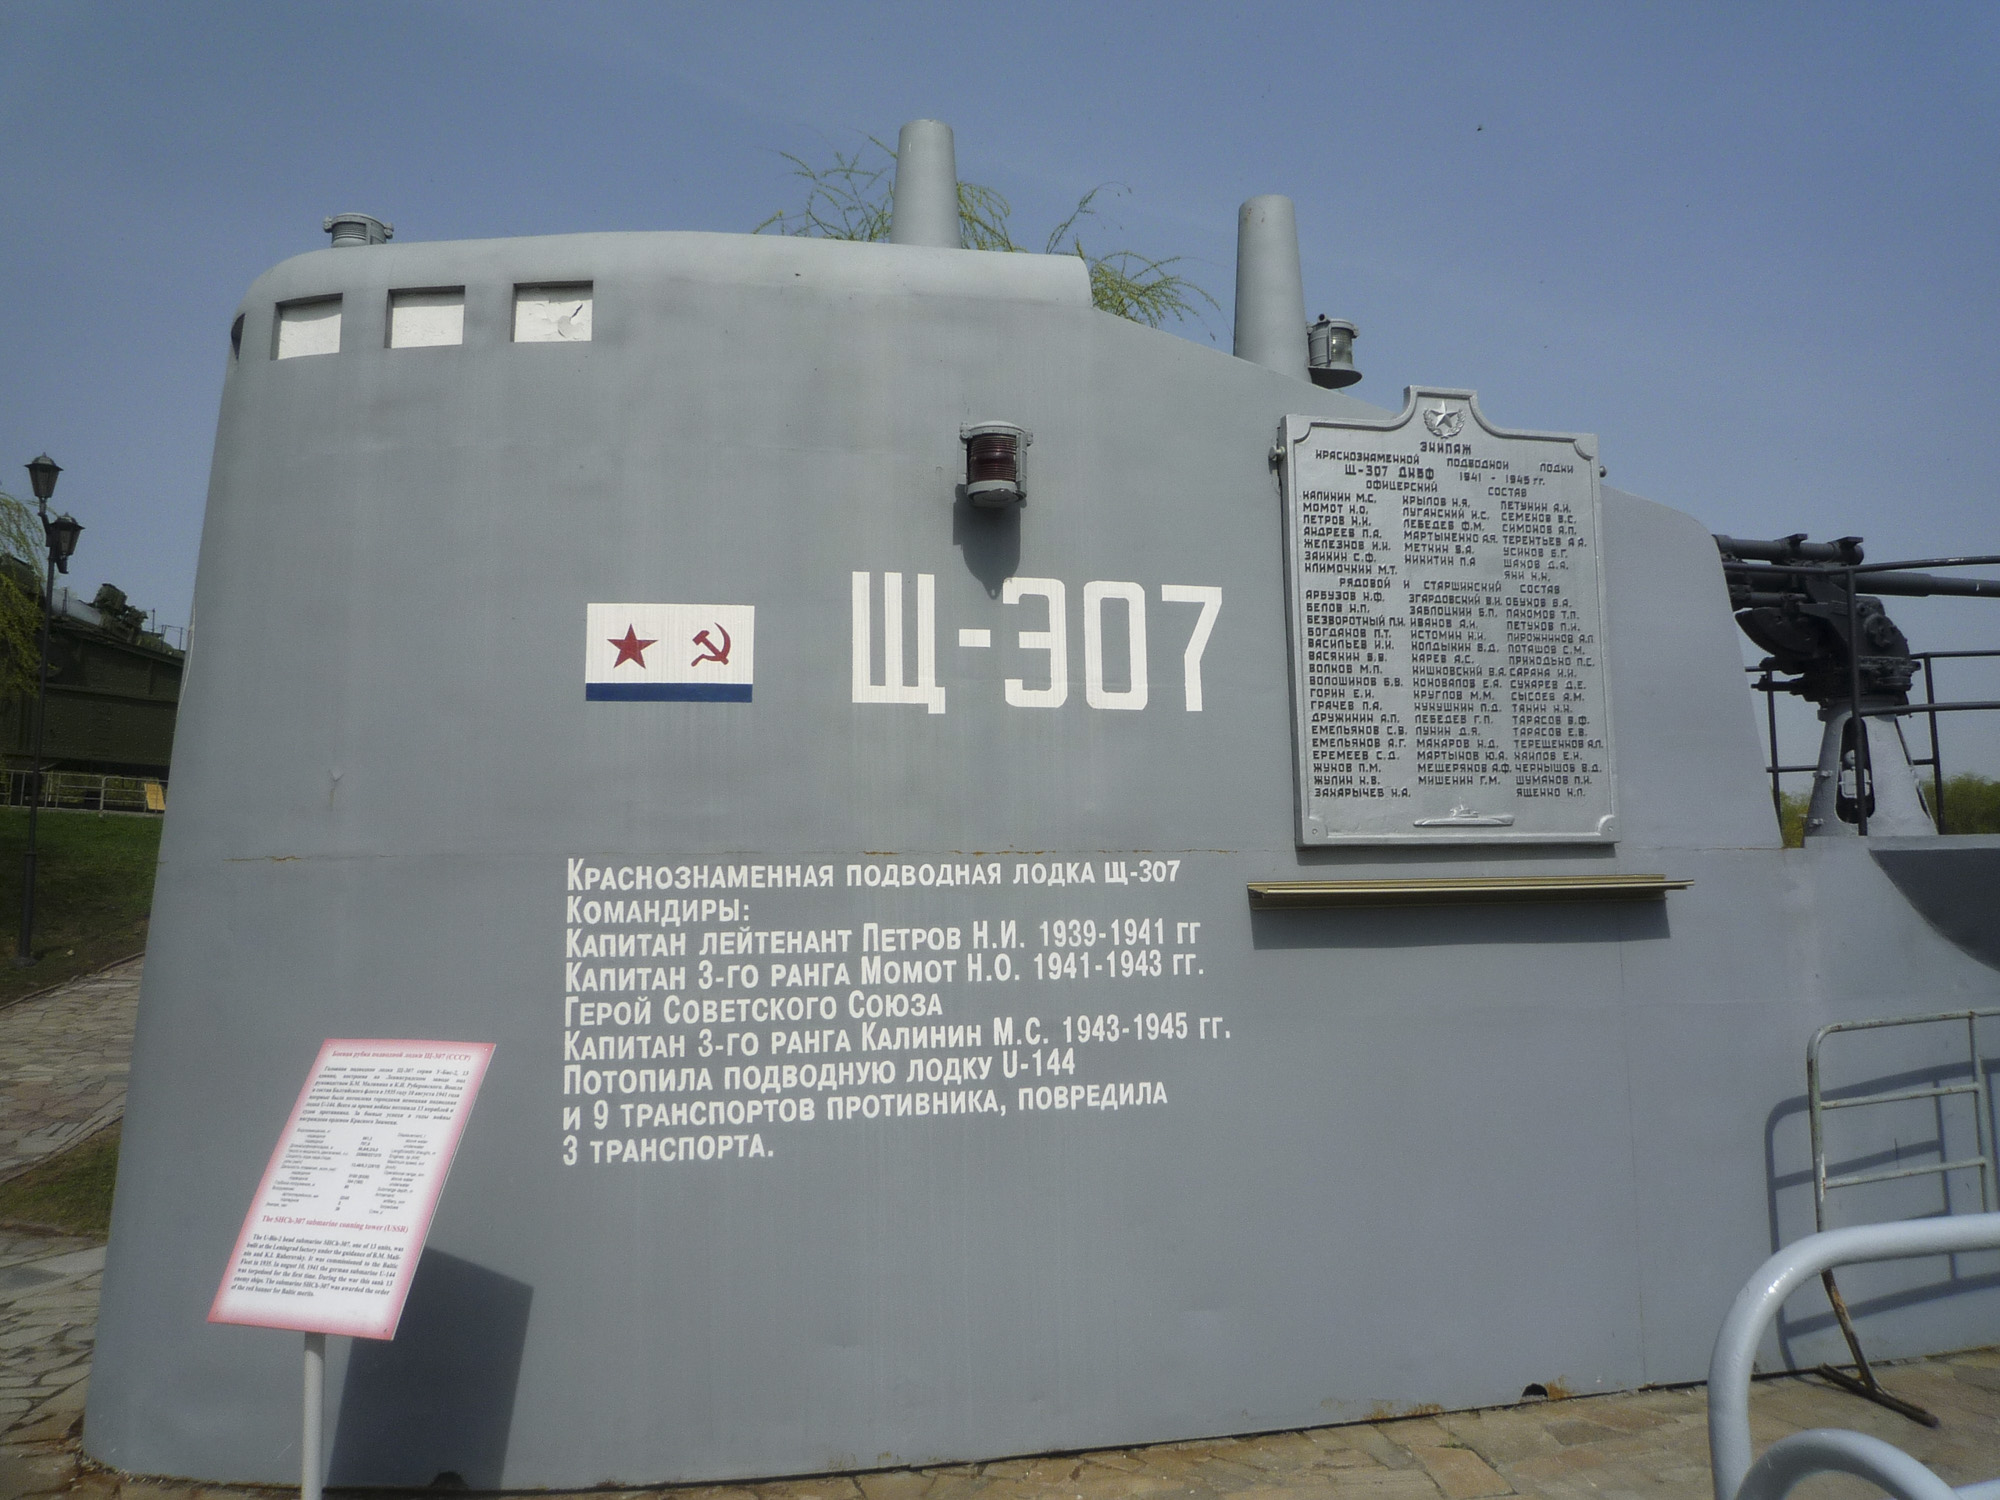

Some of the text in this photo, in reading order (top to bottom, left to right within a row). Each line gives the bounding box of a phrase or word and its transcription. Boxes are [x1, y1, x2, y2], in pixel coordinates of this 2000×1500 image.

[1419, 441, 1471, 455] ЭКИПАЖ
[1315, 449, 1419, 465] КРАСНОЗНАМЕННОЙ
[1539, 462, 1574, 474] ЛОДКИ
[1398, 466, 1434, 480] ДКБФ
[1459, 471, 1481, 482] 1941
[1505, 474, 1530, 485] 1945
[1365, 479, 1527, 497] ОФИЦЕРСКИЙ СОСТАВ
[1302, 490, 1351, 502] КАЛИНИН
[1402, 495, 1446, 506] КРЫЛОВ
[1302, 502, 1343, 513] МОМОТ
[1402, 507, 1464, 519] ЛУГАНСКИЙ
[1303, 514, 1344, 525] ПЕТРОВ
[1501, 511, 1551, 523] СЕМЕНОВ
[1403, 518, 1454, 530] ЛЕБЕДЕВ
[1502, 523, 1552, 534] СИМОНОВ
[1303, 526, 1355, 538] АНДРЕЕВ
[1403, 530, 1478, 543] МАРТЫНЕНКО
[1303, 538, 1364, 550] ЖЕЛЕЗНОВ
[1502, 534, 1561, 546] ТЕРЕНТЬЕВ
[1304, 562, 1372, 574] КЛИМОЧКИН
[1339, 576, 1560, 594] РЯДОВОЙ И СТАРШИНСКИЙ СОСТАВ
[1305, 589, 1356, 601] АРБУЗОВ
[1306, 602, 1342, 612] БЕЛОВ
[1506, 608, 1555, 619] ПАХОМОВ
[1306, 614, 1385, 626] БЕЗВОРОТНЫЙ
[1410, 617, 1452, 628] ИВАНОВ
[1506, 620, 1554, 631] ПЕТУХОВ
[1307, 627, 1366, 638] БОГДАНОВ
[1410, 629, 1462, 640] ИСТОМИН
[852, 571, 1223, 715] Щ-307
[1307, 637, 1367, 650] ВАСИЛЬЕВ
[1411, 653, 1446, 663] КАРЕВ
[1308, 663, 1352, 674] ВОЛКОВ
[1309, 675, 1376, 686] ВОЛОШИНОВ
[1412, 677, 1475, 688] КОНОВАЛОВ
[1510, 679, 1558, 689] СУХАРЕВ
[1413, 689, 1462, 700] КРУГЛОВ
[1510, 691, 1555, 701] СЫСОЕВ
[1310, 700, 1354, 710] ГРАЧЕВ
[1413, 702, 1473, 712] КУКУШКИН
[1311, 712, 1373, 723] ДРУЖИНИН
[1414, 714, 1466, 724] ЛЕБЕДЕВ
[1511, 715, 1561, 725] ТАРАСОВ
[1311, 725, 1379, 735] ЕМЕЛЬЯНОВ
[1512, 727, 1561, 736] ТАРАСОВ
[1311, 737, 1381, 748] ЕМЕЛЬЯНОВ
[1312, 750, 1368, 760] ЕРЕМЕЕВ
[1416, 750, 1479, 760] МАРТЫНОВ
[1313, 762, 1352, 773] ЖУКОВ
[1515, 763, 1575, 772] ЧЕРНЫШОВ
[1314, 787, 1384, 798] ЗАХАРЫЧЕВ
[1040, 918, 1164, 947] 1939-1941
[1034, 950, 1162, 980] 1941-1943
[1063, 1012, 1188, 1043] 1943-1945
[1003, 1048, 1075, 1079] U-144
[594, 1100, 609, 1130] 9
[563, 1135, 578, 1166] 3
[262, 1214, 274, 1222] The
[305, 1218, 338, 1227] submarine
[338, 1222, 364, 1231] conning
[364, 1223, 384, 1231] tower
[383, 1224, 408, 1233] (USSR)
